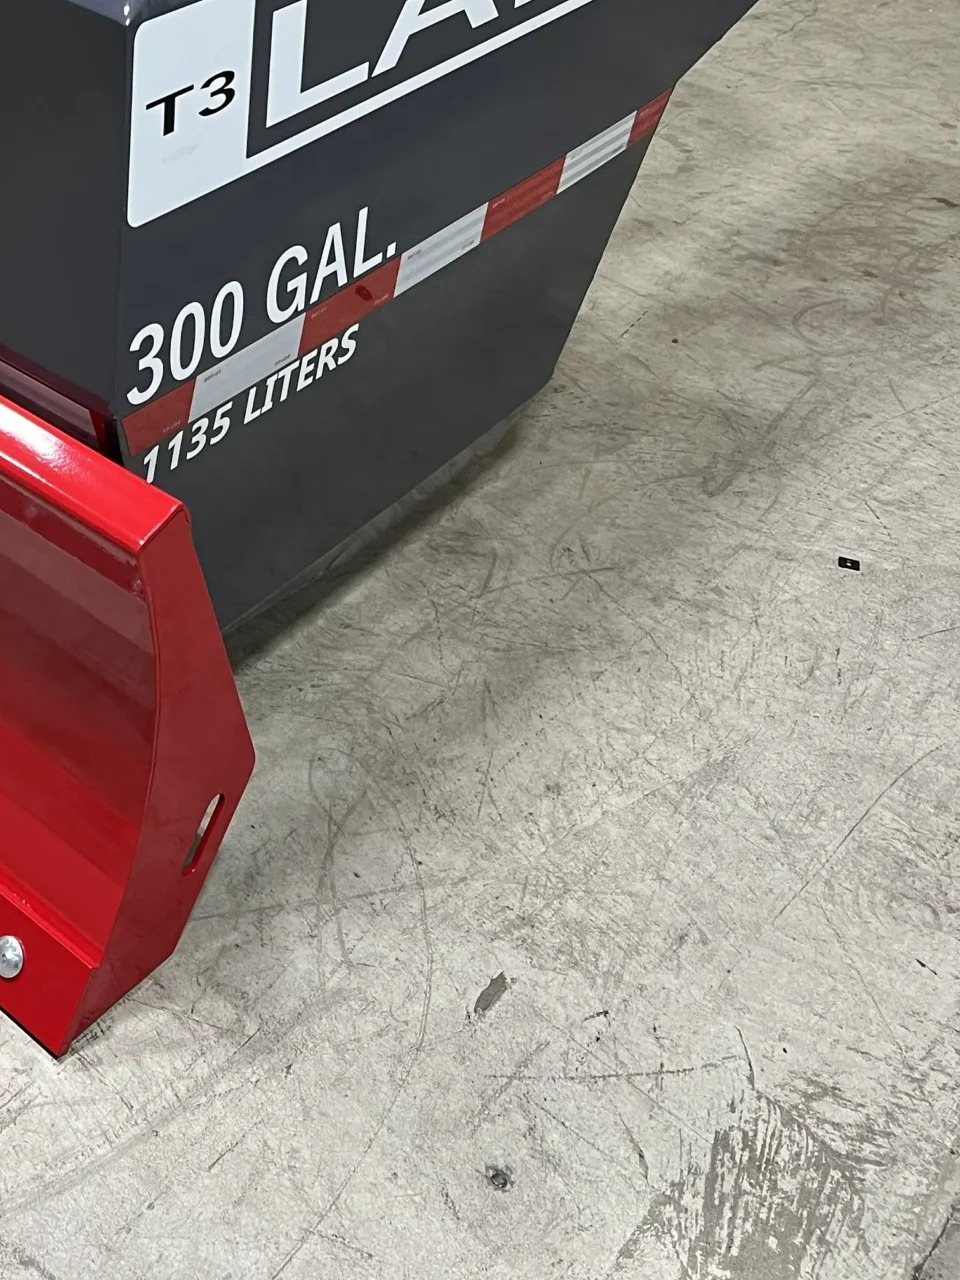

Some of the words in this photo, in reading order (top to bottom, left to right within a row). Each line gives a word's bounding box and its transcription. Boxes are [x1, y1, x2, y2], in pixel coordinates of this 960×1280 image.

[145, 69, 236, 137] T3
[126, 279, 244, 406] 300
[265, 206, 397, 324] GAL.
[143, 400, 234, 484] 1135
[243, 322, 360, 425] LITERS
